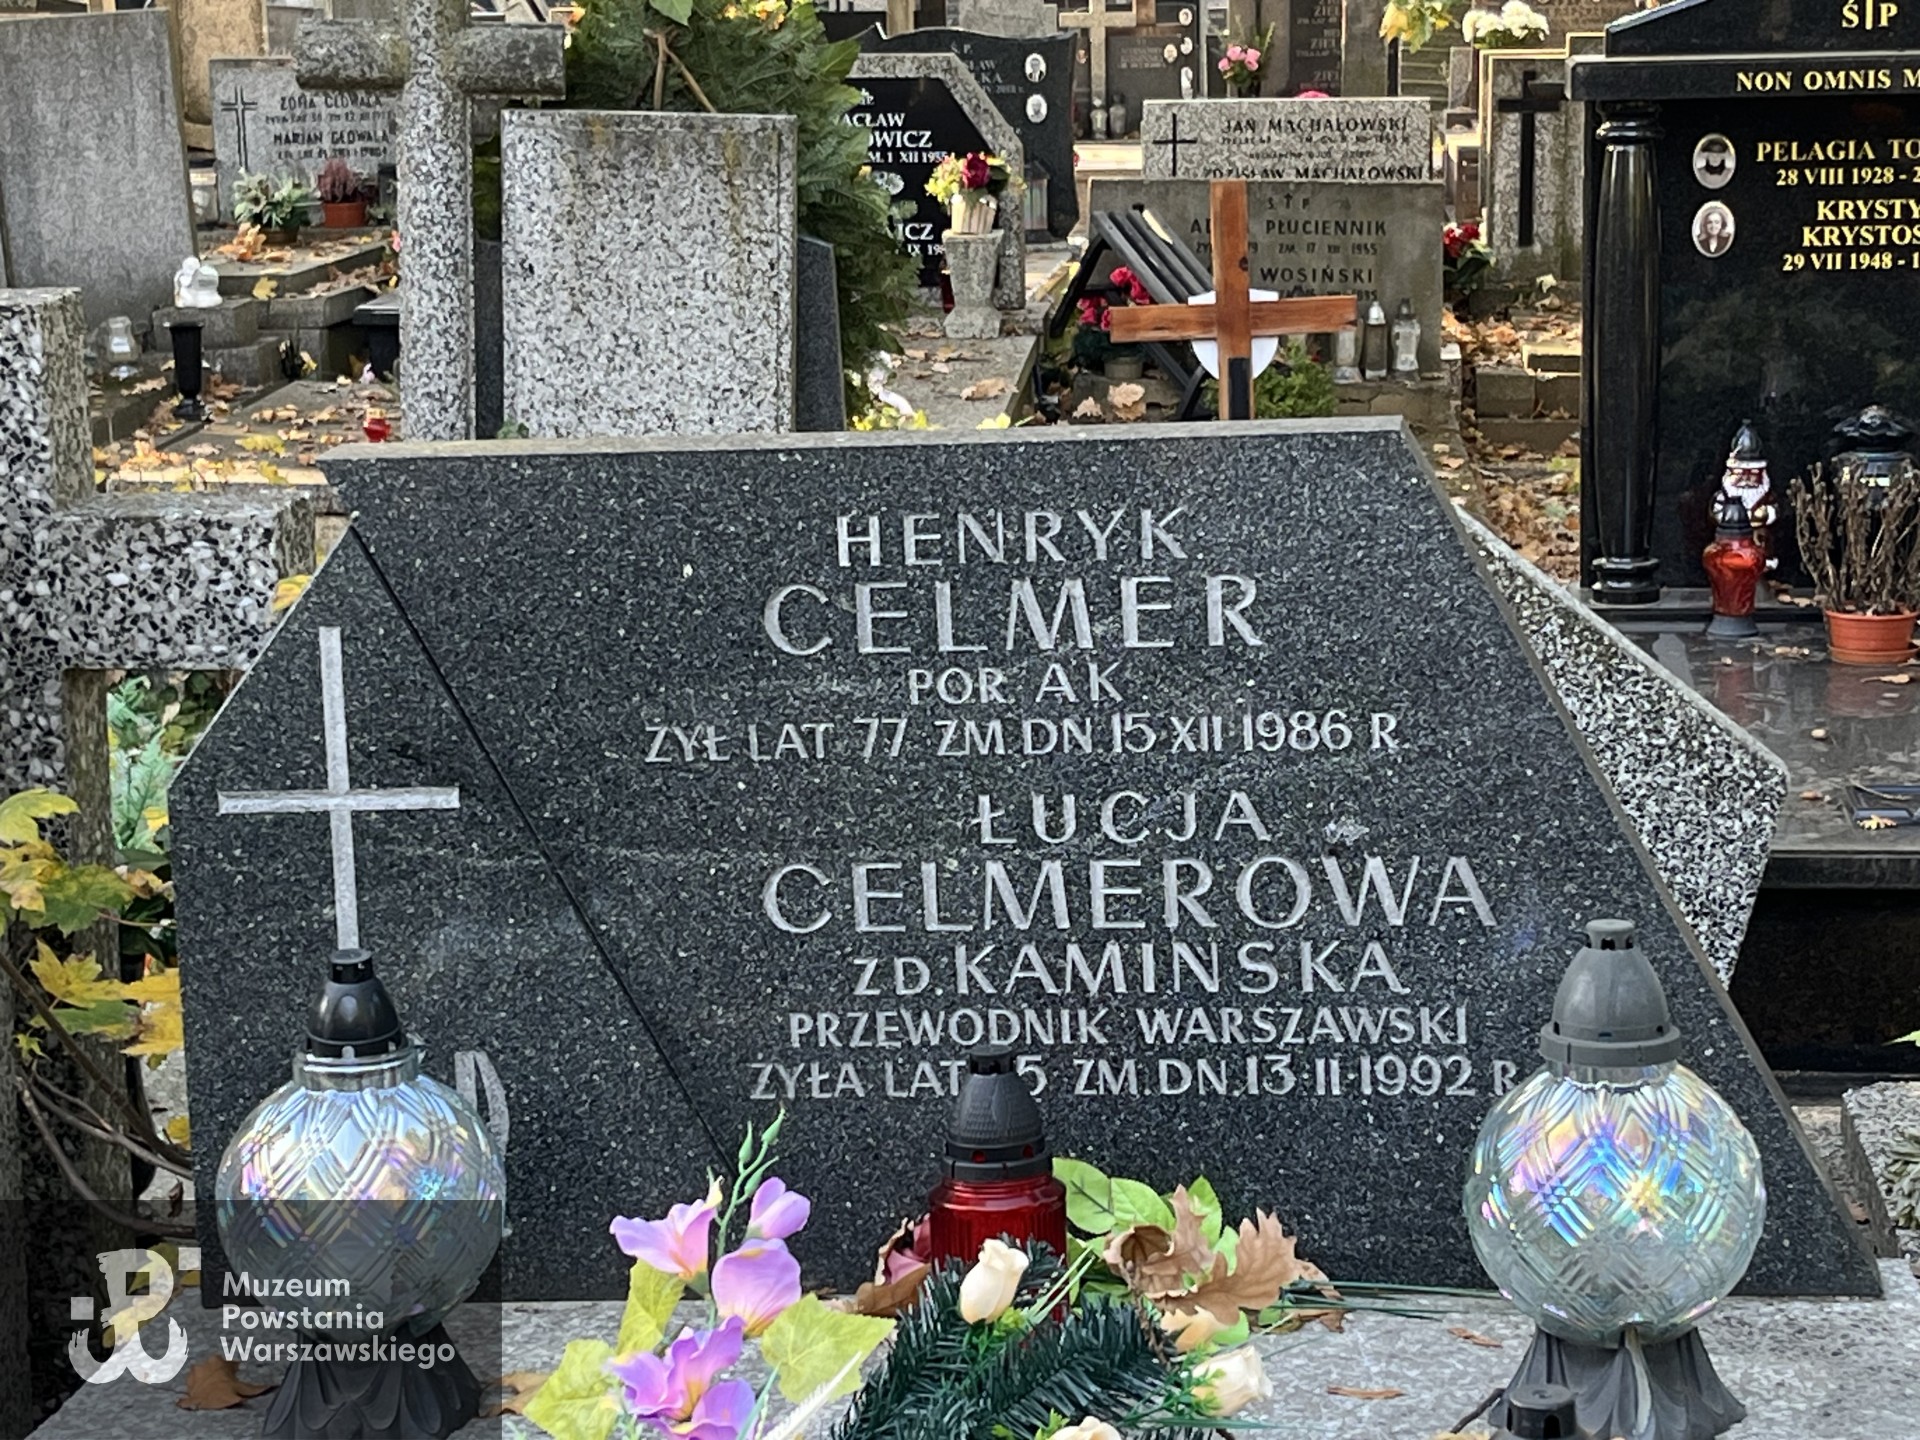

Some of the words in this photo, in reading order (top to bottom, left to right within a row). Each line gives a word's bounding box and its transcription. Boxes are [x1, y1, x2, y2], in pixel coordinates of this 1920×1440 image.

[1736, 71, 1793, 92] NON
[1803, 68, 1892, 91] OMNIS
[842, 112, 906, 127] ACŁAW
[1221, 118, 1257, 134] JAN
[1267, 115, 1409, 134] MACHAŁOWSKI
[868, 130, 934, 149] WICZ
[899, 151, 919, 163] XII
[1756, 140, 1876, 163] PELAGIA
[1776, 169, 1799, 187] 28
[1804, 167, 1845, 186] VIII
[1851, 166, 1895, 184] 1928
[894, 222, 935, 241] ICZ
[1265, 218, 1388, 237] PŁUCIENNIK
[1782, 254, 1806, 272] 29
[1810, 253, 1844, 271] VII
[1849, 252, 1893, 270] 1948
[1260, 263, 1374, 284] WOSIŃSKI
[836, 507, 1188, 567] HENRYK
[764, 574, 1263, 655] CELMER
[747, 719, 835, 762] LAT
[852, 715, 910, 759] 77
[1112, 711, 1158, 754] 15
[1170, 715, 1224, 754] XII
[1243, 709, 1353, 753] 1986
[1370, 711, 1400, 753] R
[971, 789, 1272, 845] ŁUCJA
[763, 855, 1499, 934] CELMEROWA
[788, 1006, 1110, 1049] PRZEWODNIK
[1135, 1005, 1468, 1047] WARSZAWSKI
[883, 1057, 968, 1098] LAT
[1015, 1053, 1049, 1097] 5
